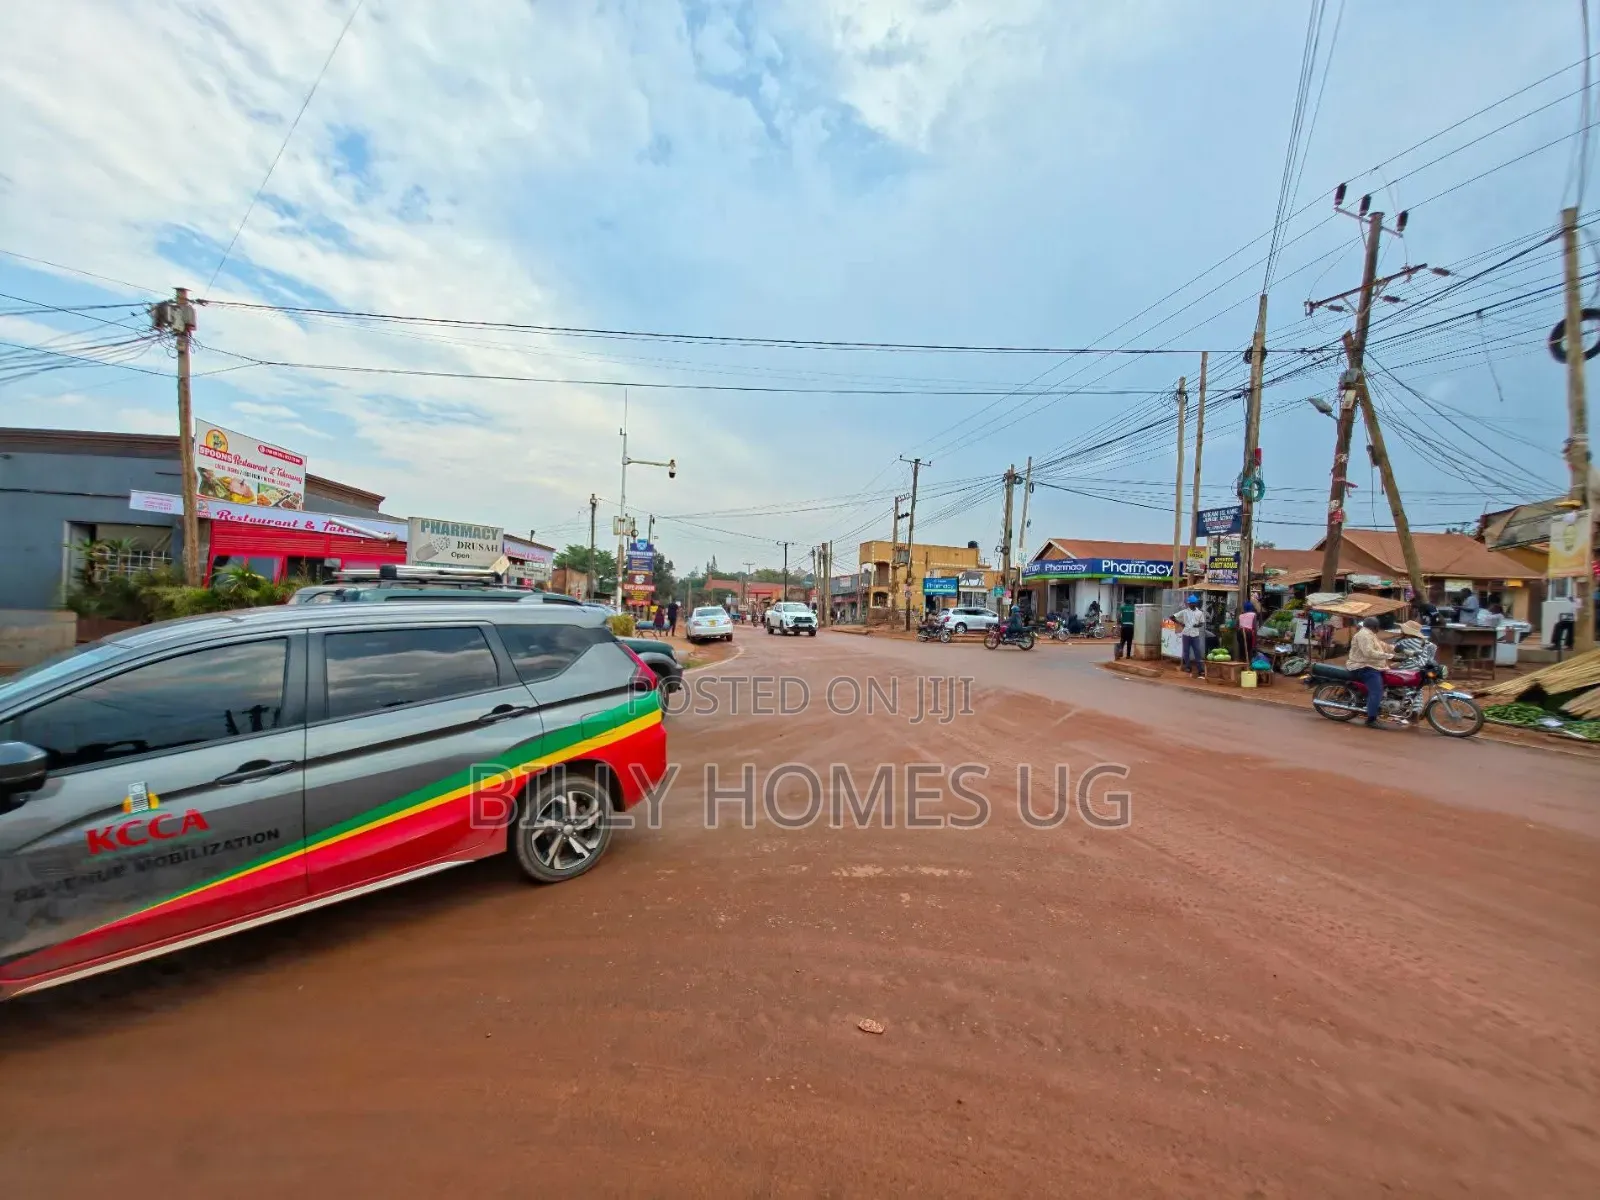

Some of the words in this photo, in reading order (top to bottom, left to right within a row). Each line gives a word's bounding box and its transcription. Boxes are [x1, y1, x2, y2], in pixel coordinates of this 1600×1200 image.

[199, 446, 232, 463] SPOONS
[233, 454, 268, 472] Restaurant
[277, 467, 302, 484] Takeaway
[217, 510, 298, 527] Restaurant
[305, 521, 315, 530] &
[420, 520, 498, 540] PHARMACY
[451, 551, 470, 559] Open
[456, 541, 498, 552] DRUSAH
[1044, 563, 1088, 573] Pharmacy
[1102, 560, 1174, 576] Pharmacy
[85, 809, 210, 855] KCCA
[134, 828, 280, 873] MOBILIZATION
